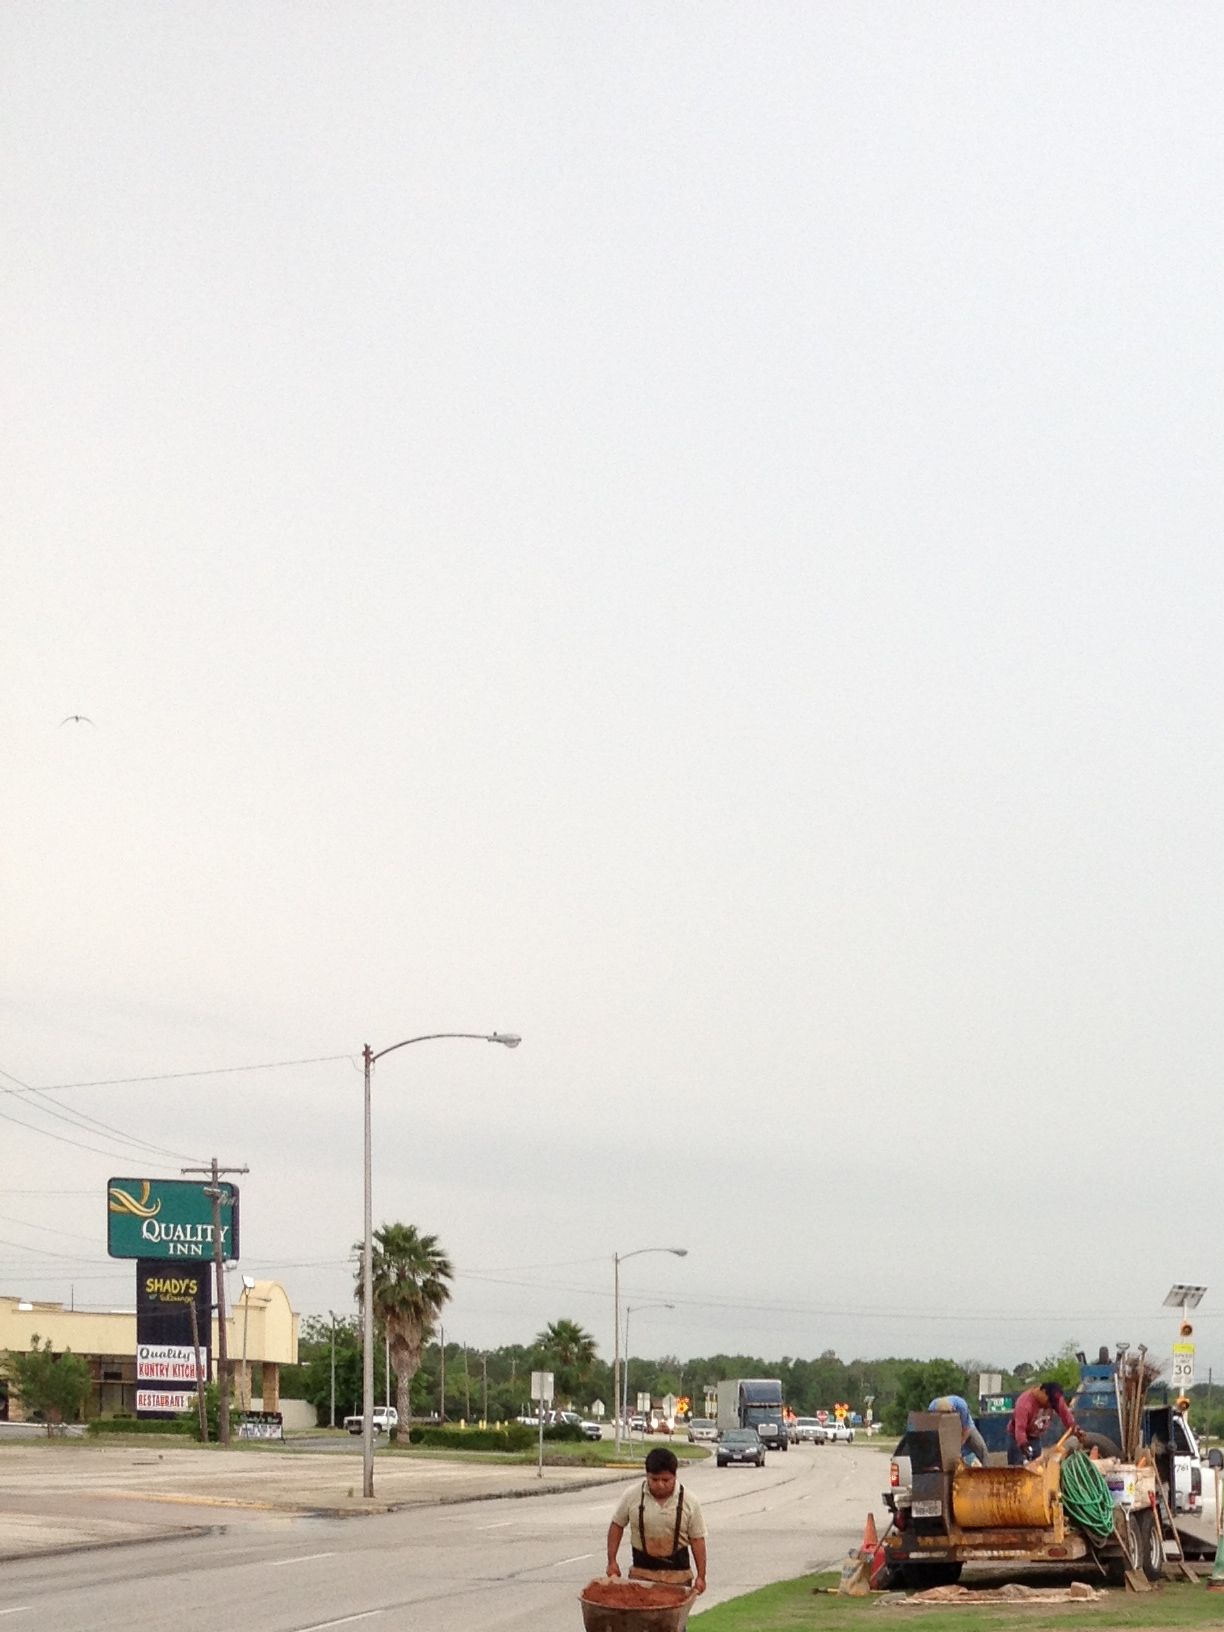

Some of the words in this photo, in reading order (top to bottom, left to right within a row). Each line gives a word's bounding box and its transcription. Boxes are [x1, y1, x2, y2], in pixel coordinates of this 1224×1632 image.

[142, 1219, 229, 1243] QUALITY
[168, 1243, 203, 1255] INN
[146, 1278, 198, 1294] SHADY'S
[139, 1347, 191, 1362] Quality
[172, 1363, 206, 1380] KITCHN
[1175, 1364, 1192, 1375] 30
